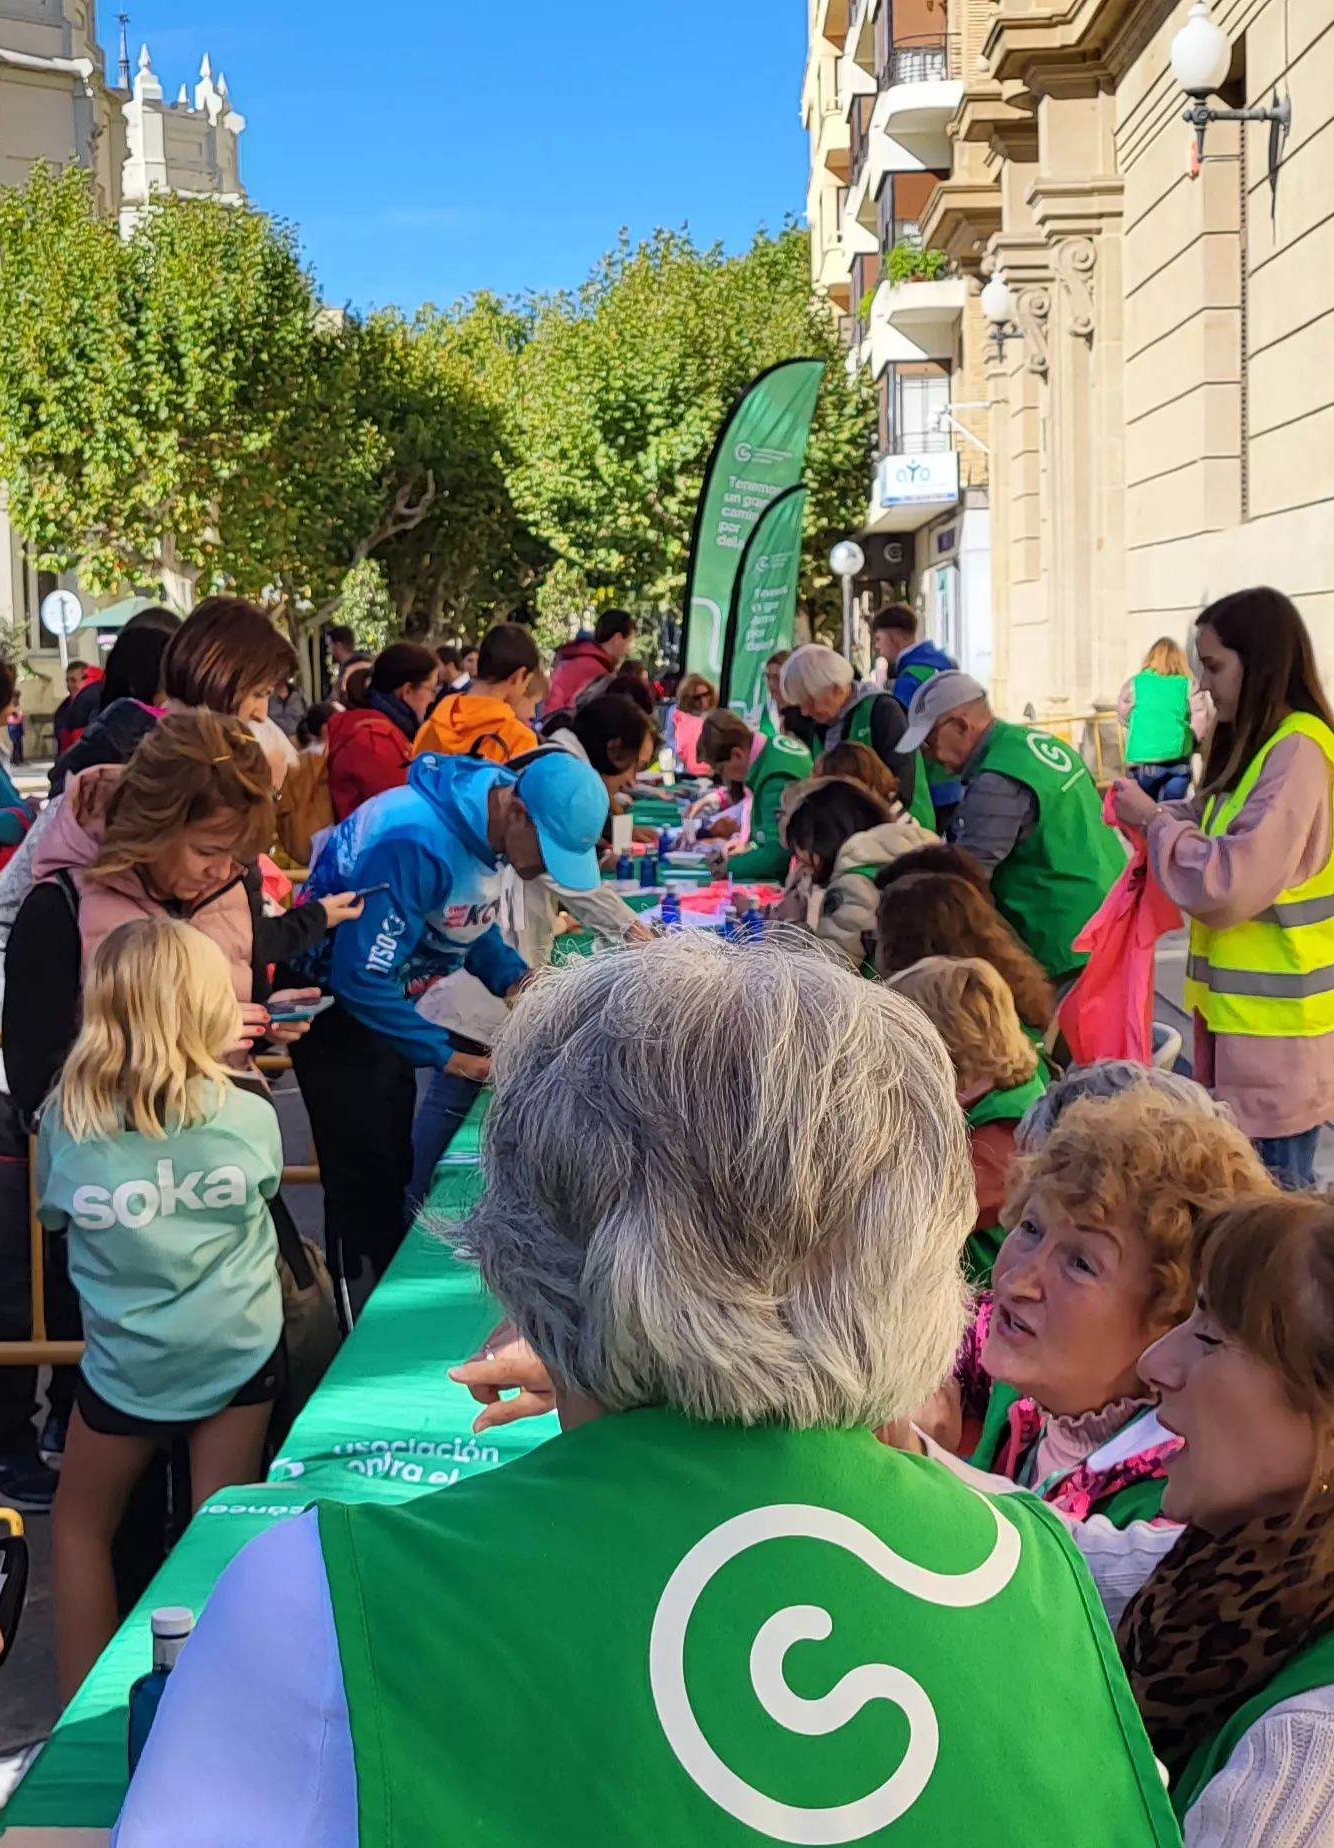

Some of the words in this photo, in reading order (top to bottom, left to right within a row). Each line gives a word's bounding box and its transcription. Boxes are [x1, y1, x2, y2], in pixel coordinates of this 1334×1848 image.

[723, 492, 741, 504] un
[721, 507, 759, 521] camin
[718, 521, 741, 534] por
[72, 1158, 247, 1230] soka
[347, 1451, 424, 1483] ontra
[427, 1468, 460, 1486] el
